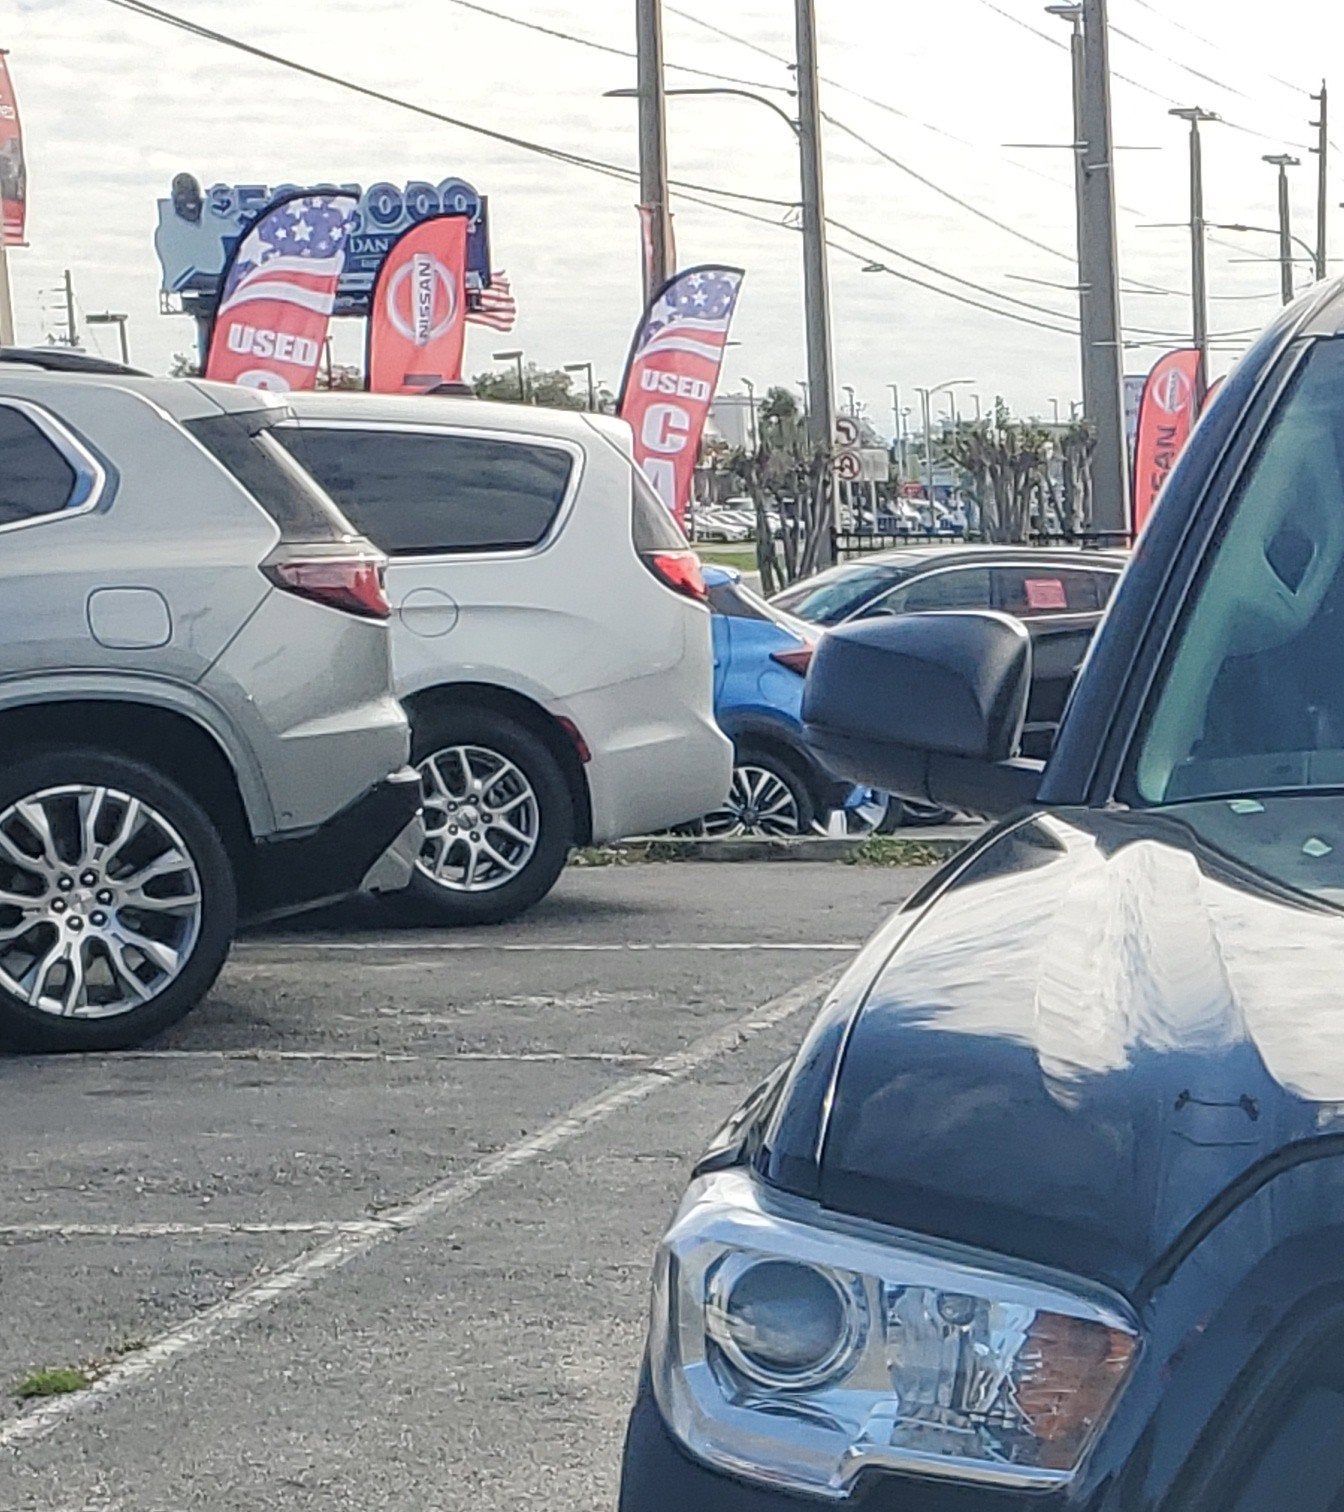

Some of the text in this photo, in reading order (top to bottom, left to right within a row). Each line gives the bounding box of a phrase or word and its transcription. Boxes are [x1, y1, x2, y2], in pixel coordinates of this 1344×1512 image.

[418, 262, 432, 338] NISSAN
[227, 322, 318, 367] USED
[640, 368, 711, 400] USED
